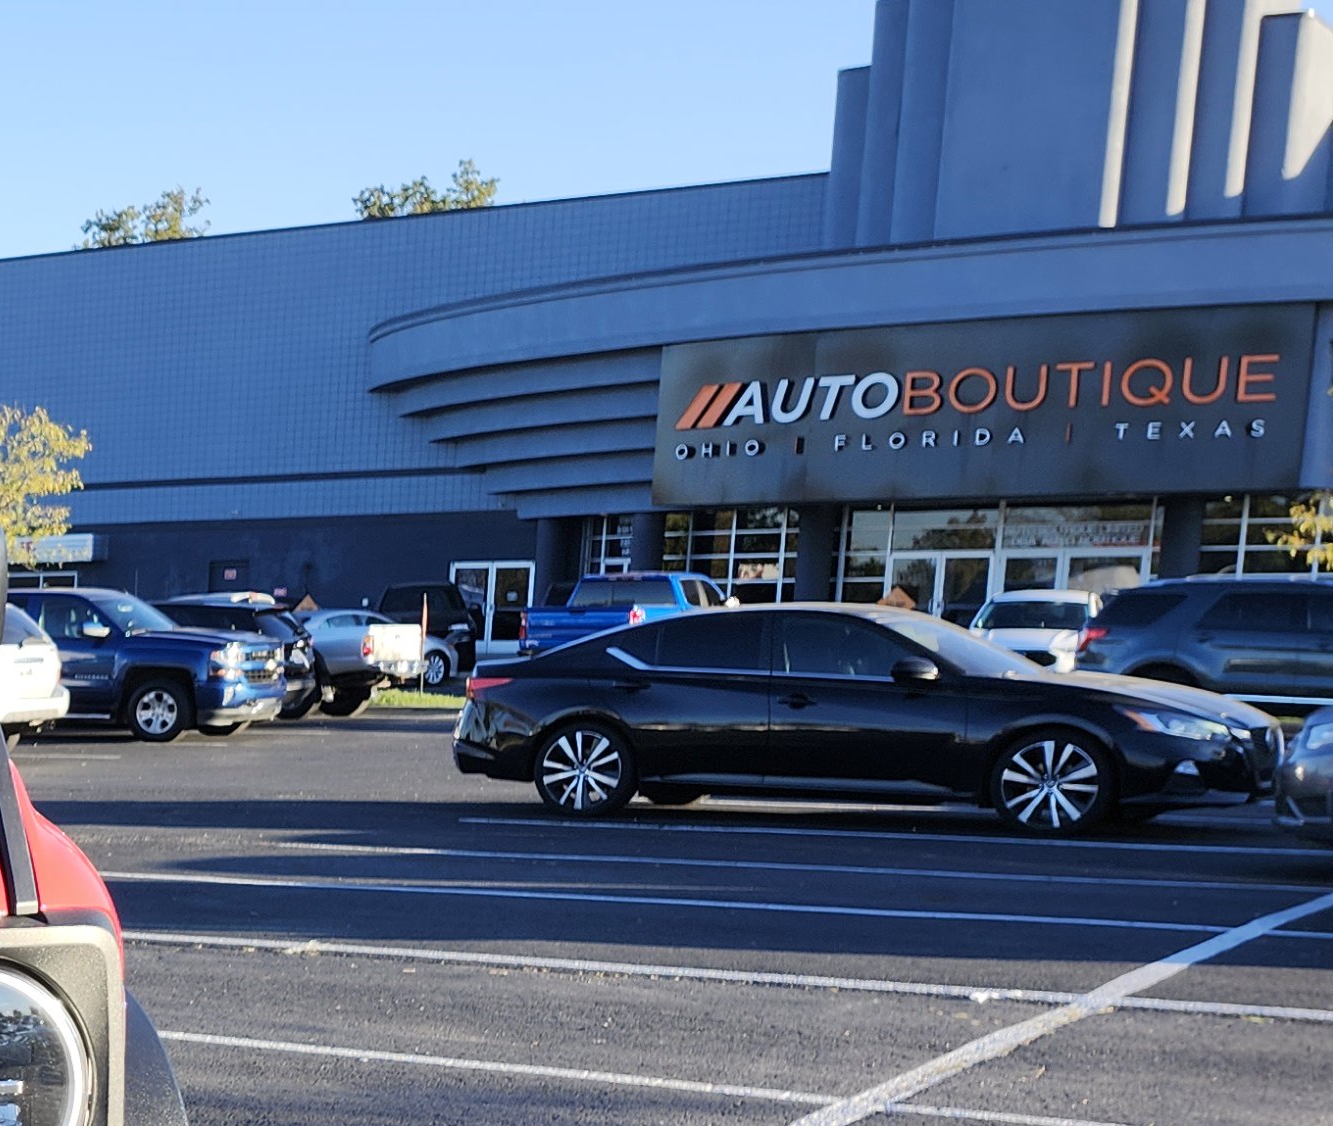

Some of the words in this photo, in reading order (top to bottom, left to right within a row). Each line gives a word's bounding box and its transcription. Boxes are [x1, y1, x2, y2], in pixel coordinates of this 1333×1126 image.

[722, 353, 1281, 426] AUTOBOUTIQUE
[675, 438, 760, 461] OHIO
[834, 426, 1025, 451] FLORIDA
[1115, 418, 1267, 440] TEXAS
